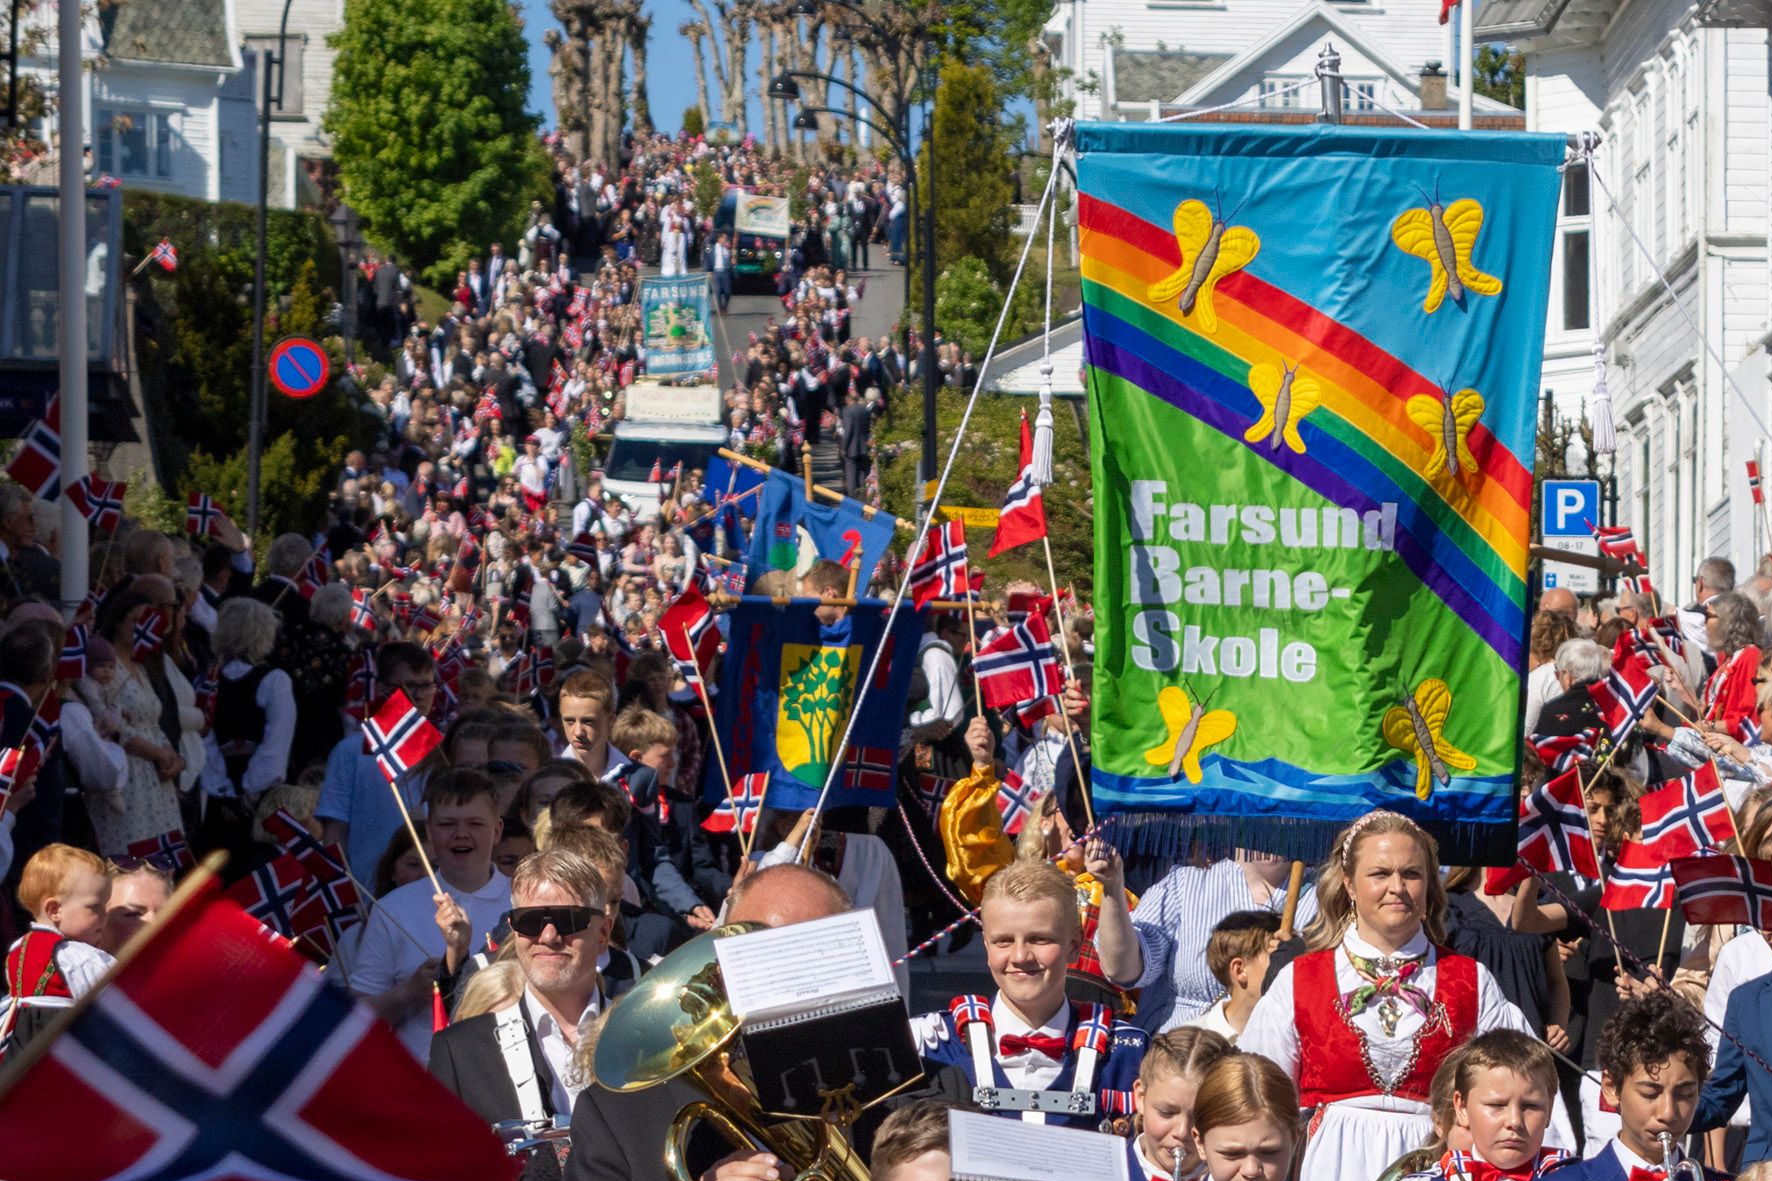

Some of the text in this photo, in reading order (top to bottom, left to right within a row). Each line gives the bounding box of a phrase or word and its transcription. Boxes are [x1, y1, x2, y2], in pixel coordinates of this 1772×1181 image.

[643, 285, 707, 300] FARSUND
[1131, 479, 1398, 552] Farsund
[1557, 488, 1585, 529] P
[1131, 545, 1351, 612] Barne-
[1131, 608, 1318, 683] Skole
